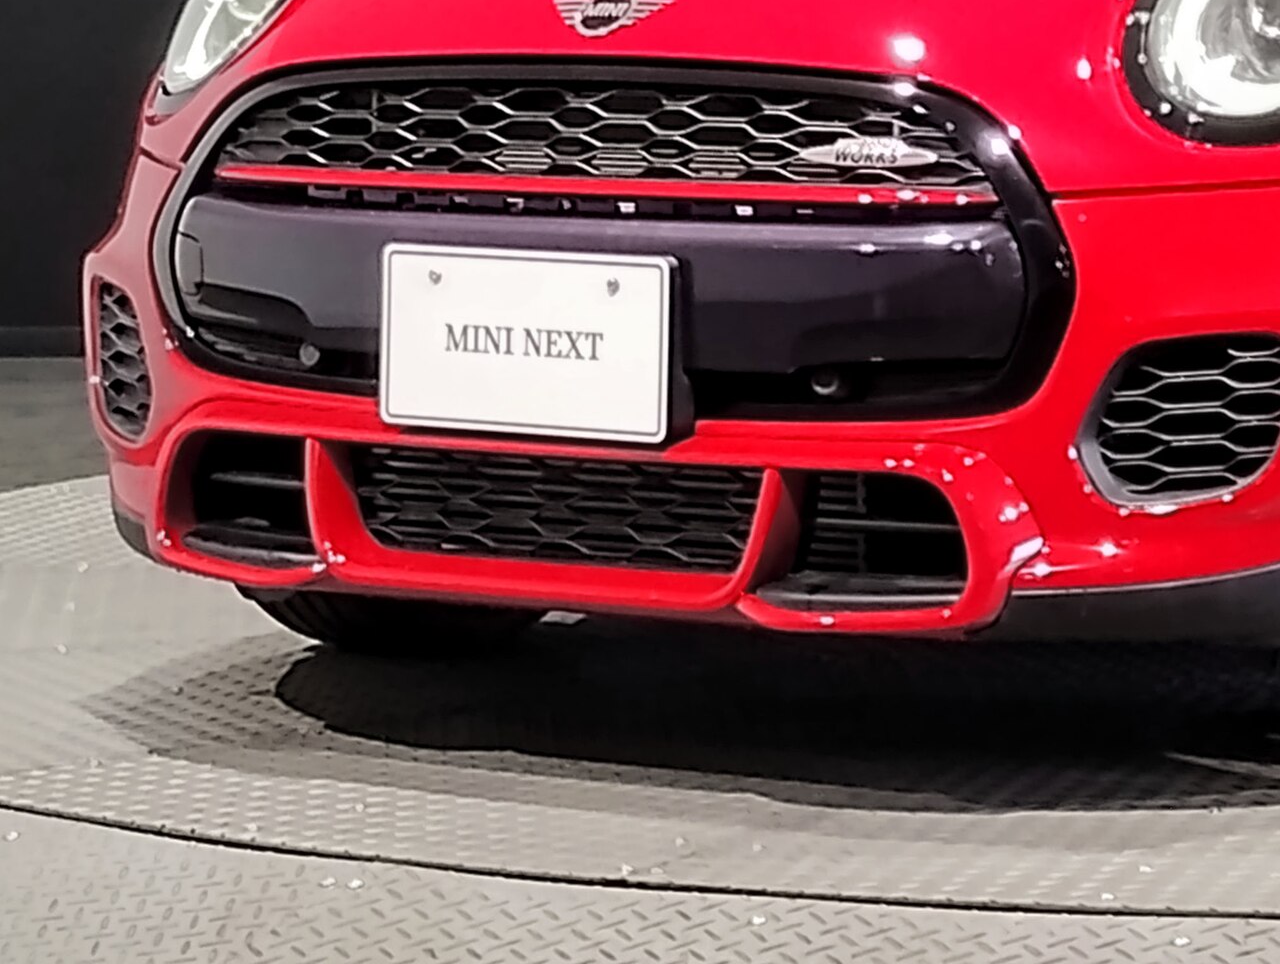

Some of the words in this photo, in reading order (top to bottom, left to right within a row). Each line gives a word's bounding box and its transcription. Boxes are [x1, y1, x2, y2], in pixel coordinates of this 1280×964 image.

[583, 2, 629, 17] MINI
[445, 323, 515, 356] MINI
[523, 327, 603, 361] NEXT
